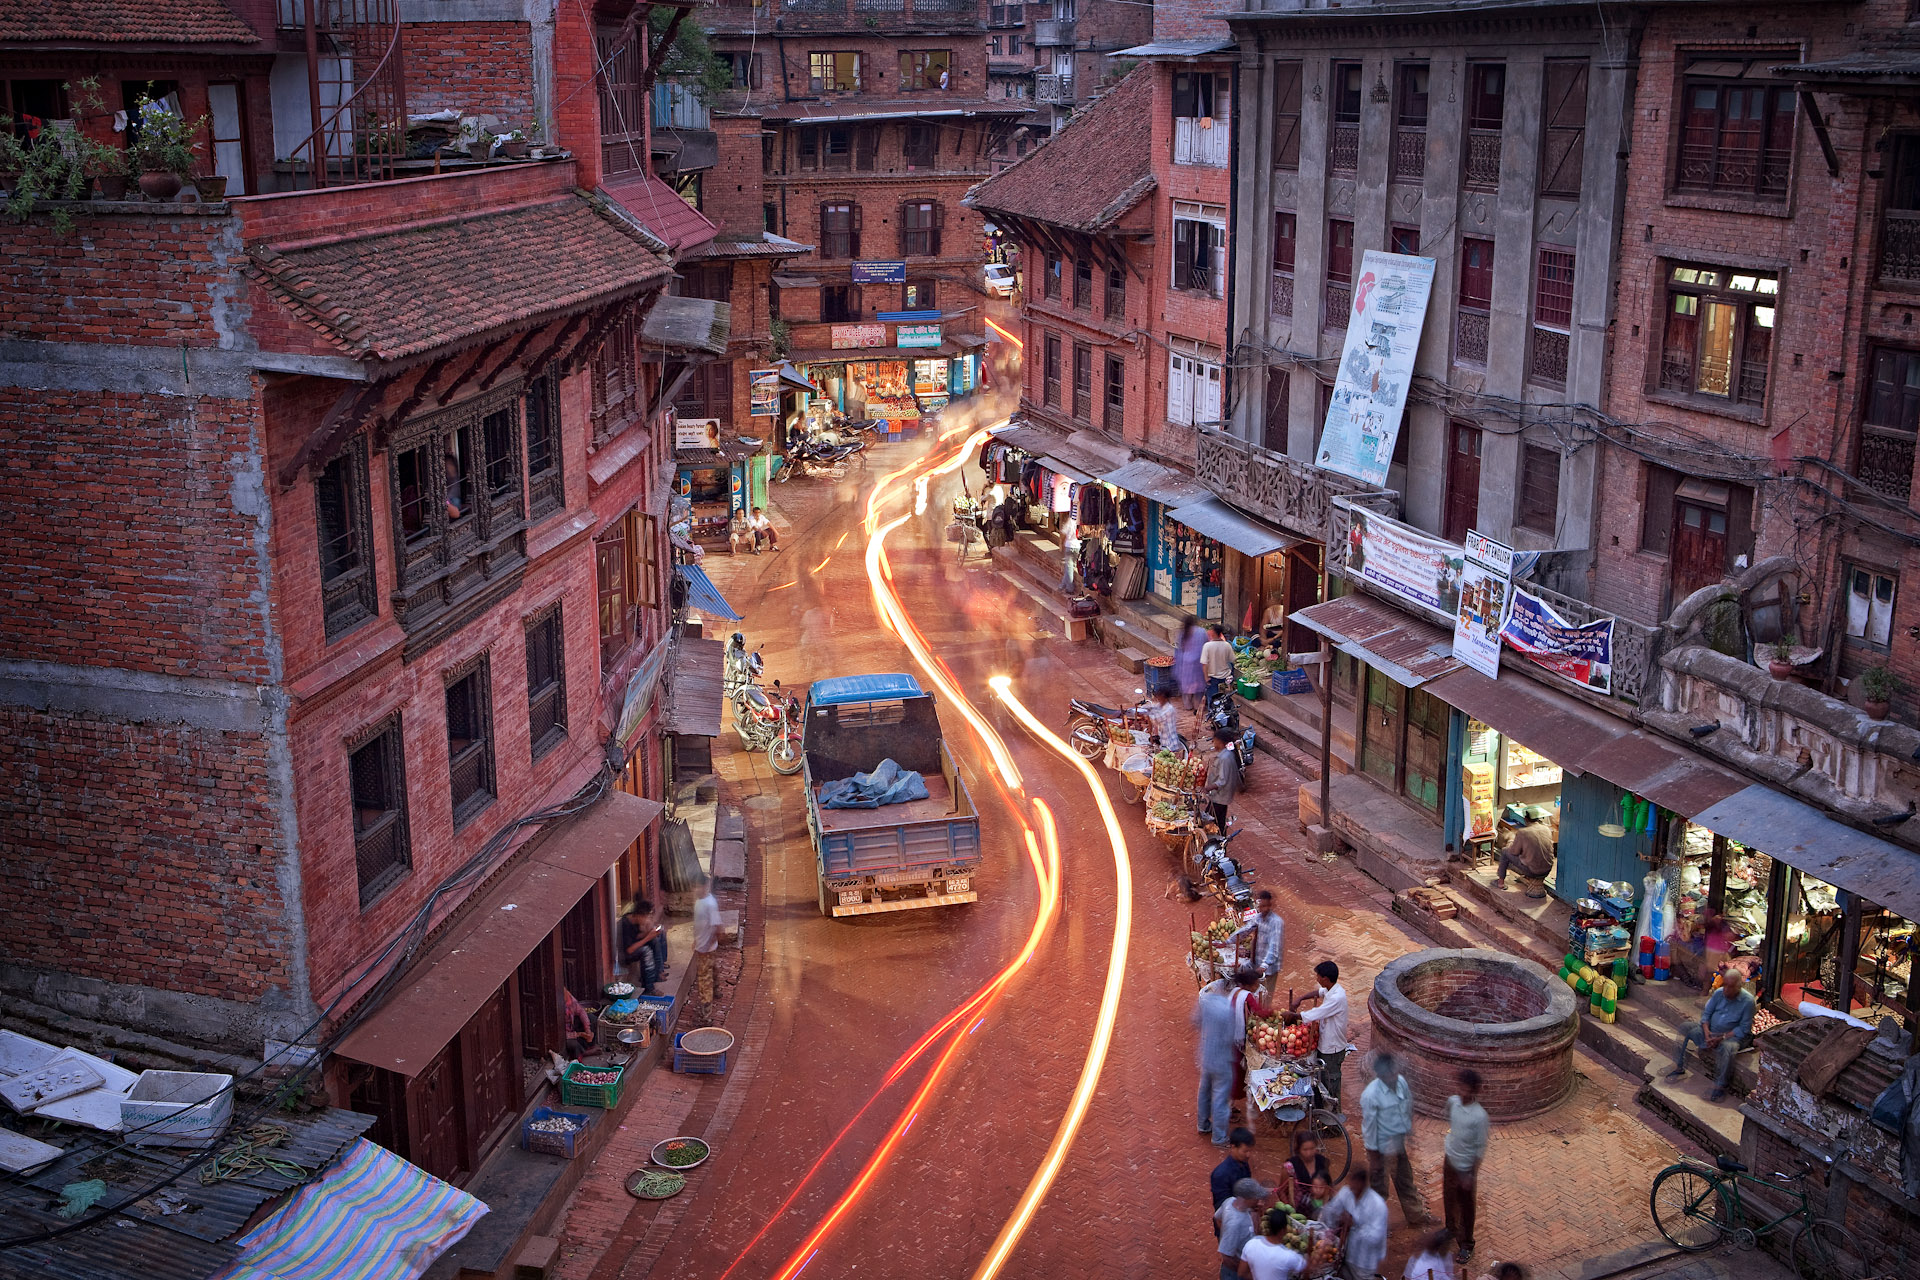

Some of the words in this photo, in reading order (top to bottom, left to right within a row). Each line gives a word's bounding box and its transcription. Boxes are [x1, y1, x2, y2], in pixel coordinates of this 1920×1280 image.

[1491, 545, 1510, 565] ENGLISH
[1456, 625, 1470, 641] Science
[1471, 633, 1497, 655] Management
[879, 872, 928, 883] Mahindra
